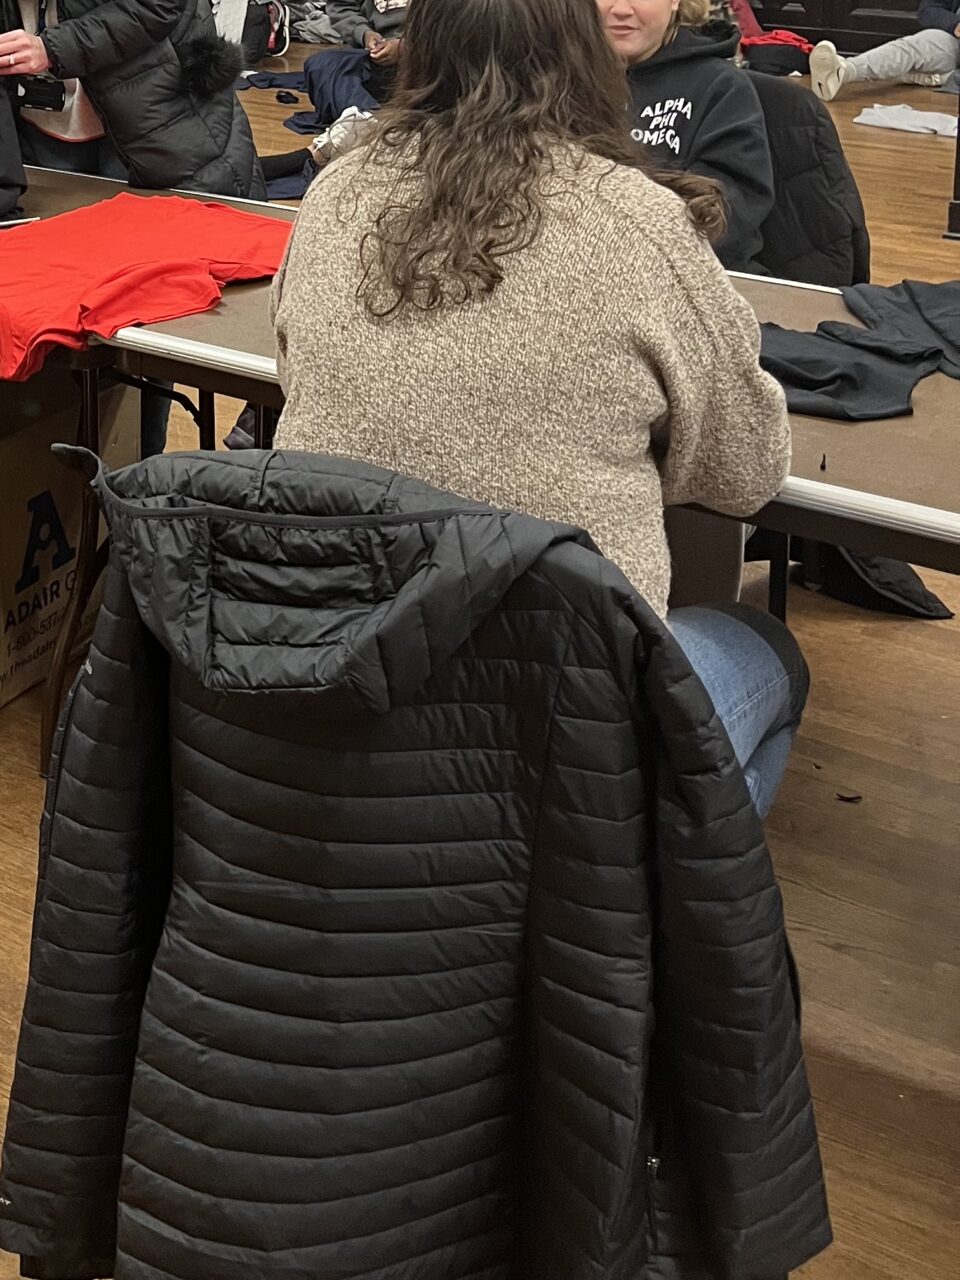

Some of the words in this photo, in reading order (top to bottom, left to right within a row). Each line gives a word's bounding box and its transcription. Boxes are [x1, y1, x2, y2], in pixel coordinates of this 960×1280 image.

[640, 97, 692, 120] ALPHA
[649, 112, 678, 129] PHI
[630, 128, 681, 155] OMEGA
[3, 579, 61, 635] ADAIR
